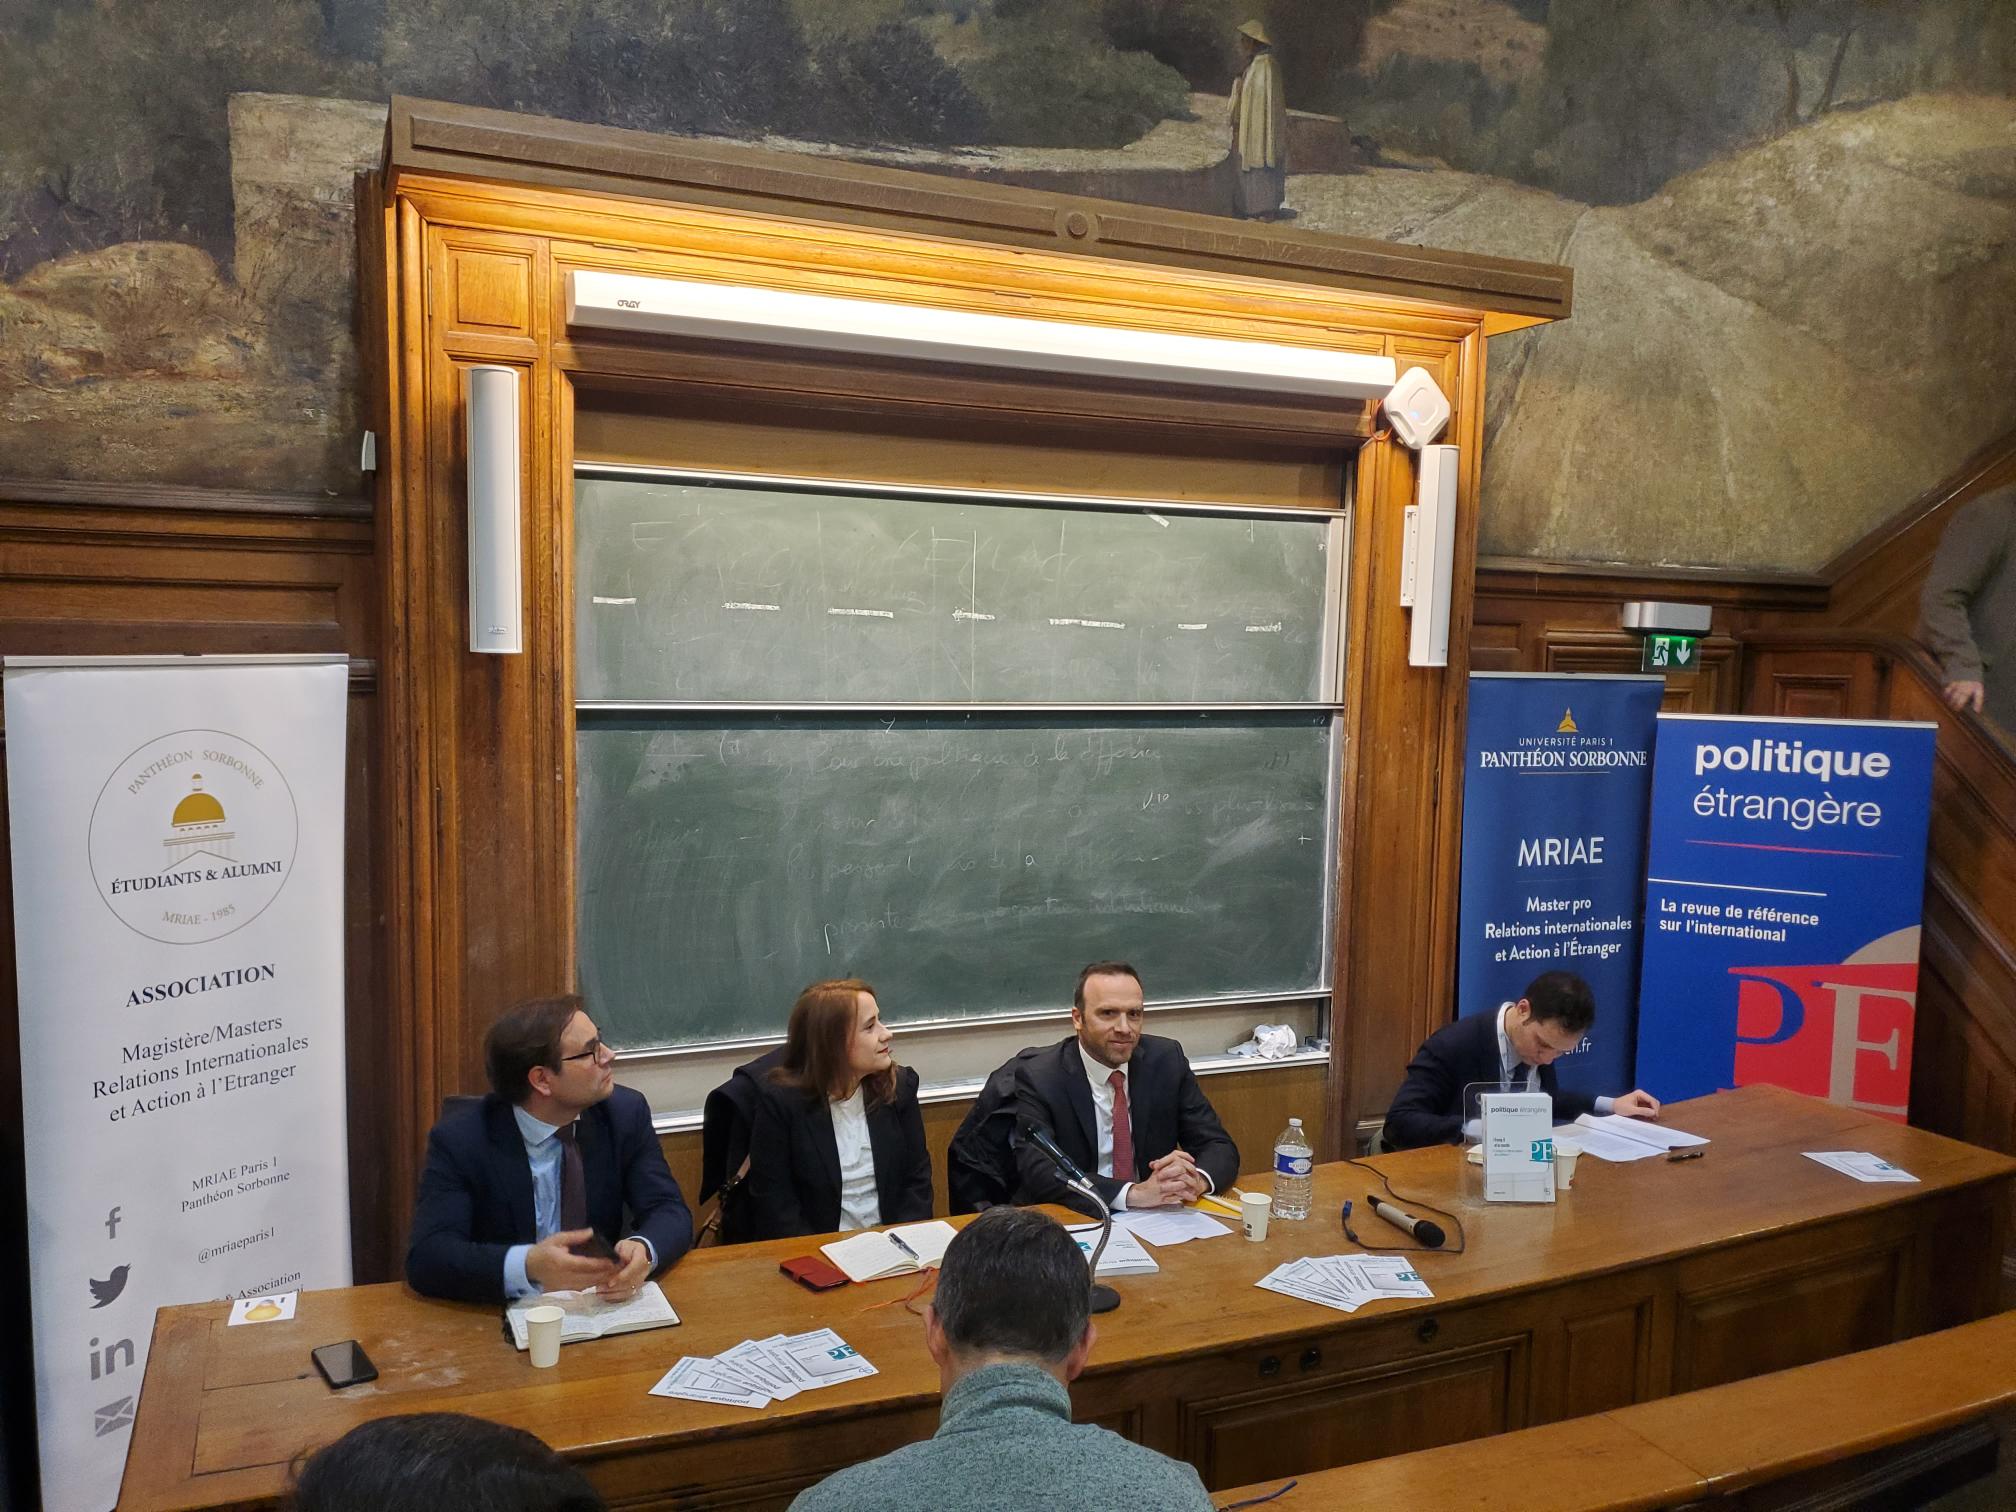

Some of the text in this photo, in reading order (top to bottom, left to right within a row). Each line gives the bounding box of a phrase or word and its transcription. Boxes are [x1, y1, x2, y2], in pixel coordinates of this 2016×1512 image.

[1518, 736, 1614, 748] UNIVERSITÉ PARIS 1
[128, 749, 265, 795] PANTHÉON SORBONNE
[1480, 747, 1647, 769] PANTHÉON SORBONNE
[1695, 739, 1891, 782] politique
[1693, 785, 1882, 830] étrangère
[1517, 836, 1605, 867] MRIAE
[111, 861, 282, 895] ÉTUDIANTS & ALUMNI
[162, 910, 201, 926] MRIAE
[210, 904, 236, 922] 1985
[1526, 896, 1592, 916] Master pro
[1660, 898, 1820, 926] La revue de référence
[1485, 917, 1632, 940] Relations internationales
[1659, 919, 1787, 943] sur l'international
[1495, 936, 1622, 962] et Action à l'Étranger
[125, 963, 276, 1008] ASSOCIATION
[122, 1015, 283, 1064] Magistère/Masters
[92, 1034, 309, 1099] Relations Internationales
[109, 1105, 126, 1122] et
[131, 1087, 191, 1117] Action
[196, 1082, 206, 1099] à
[1490, 1106, 1519, 1114] politique
[181, 1171, 291, 1212] Panthéon Sorbonne
[192, 1168, 237, 1192] MRIAE
[240, 1160, 269, 1178] Paris
[197, 1227, 276, 1264] @mriaeparis1
[238, 1271, 301, 1300] Association
